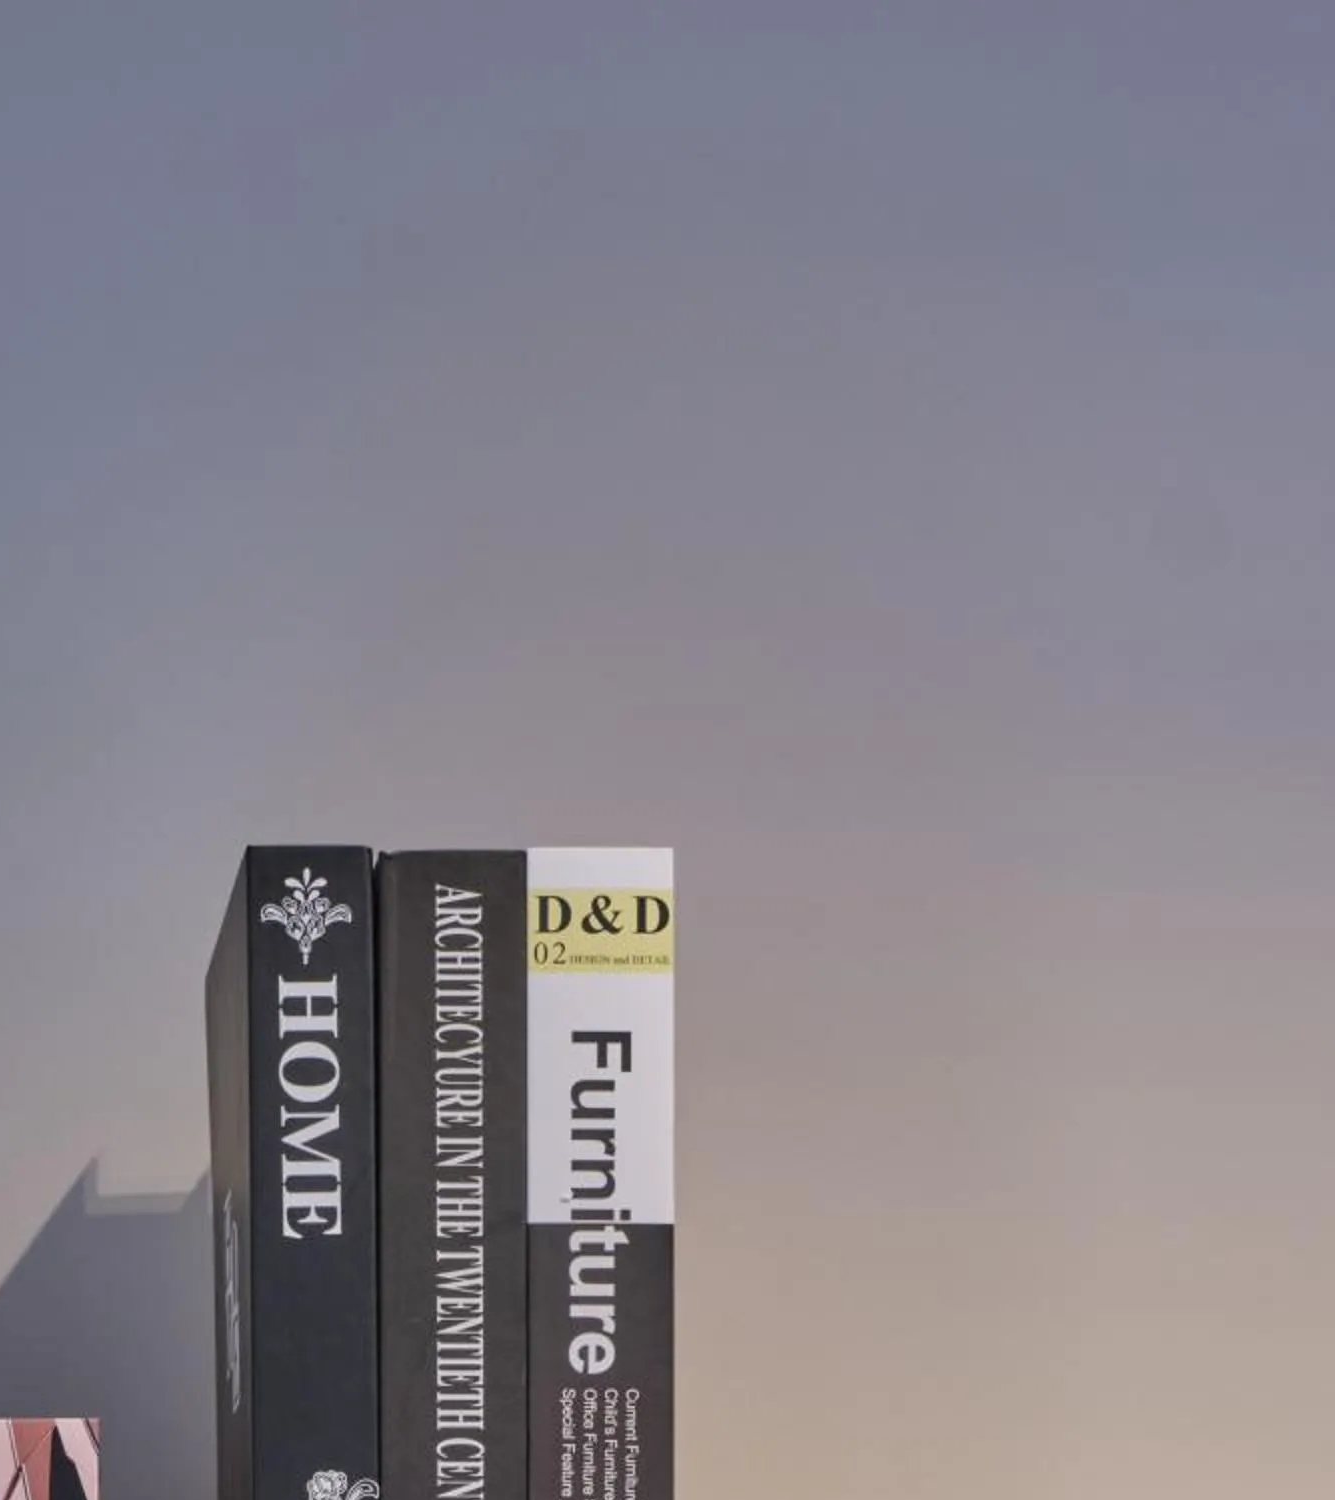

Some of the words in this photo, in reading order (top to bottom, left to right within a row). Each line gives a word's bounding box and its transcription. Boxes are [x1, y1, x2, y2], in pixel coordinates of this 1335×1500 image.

[535, 895, 572, 934] D
[581, 895, 624, 935] &
[632, 895, 670, 935] D
[435, 884, 483, 1127] ARCHITECYURE
[279, 974, 342, 1239] HOME
[436, 1136, 483, 1168] IN
[436, 1177, 483, 1238] THE
[568, 1031, 632, 1374] Furniture
[437, 1246, 484, 1429] TWENTIETH
[559, 1388, 576, 1439] Special
[583, 1388, 597, 1429] Office
[625, 1388, 639, 1440] Current
[561, 1444, 576, 1497] Feature
[582, 1433, 597, 1495] Furniture
[604, 1440, 618, 1500] Furniture
